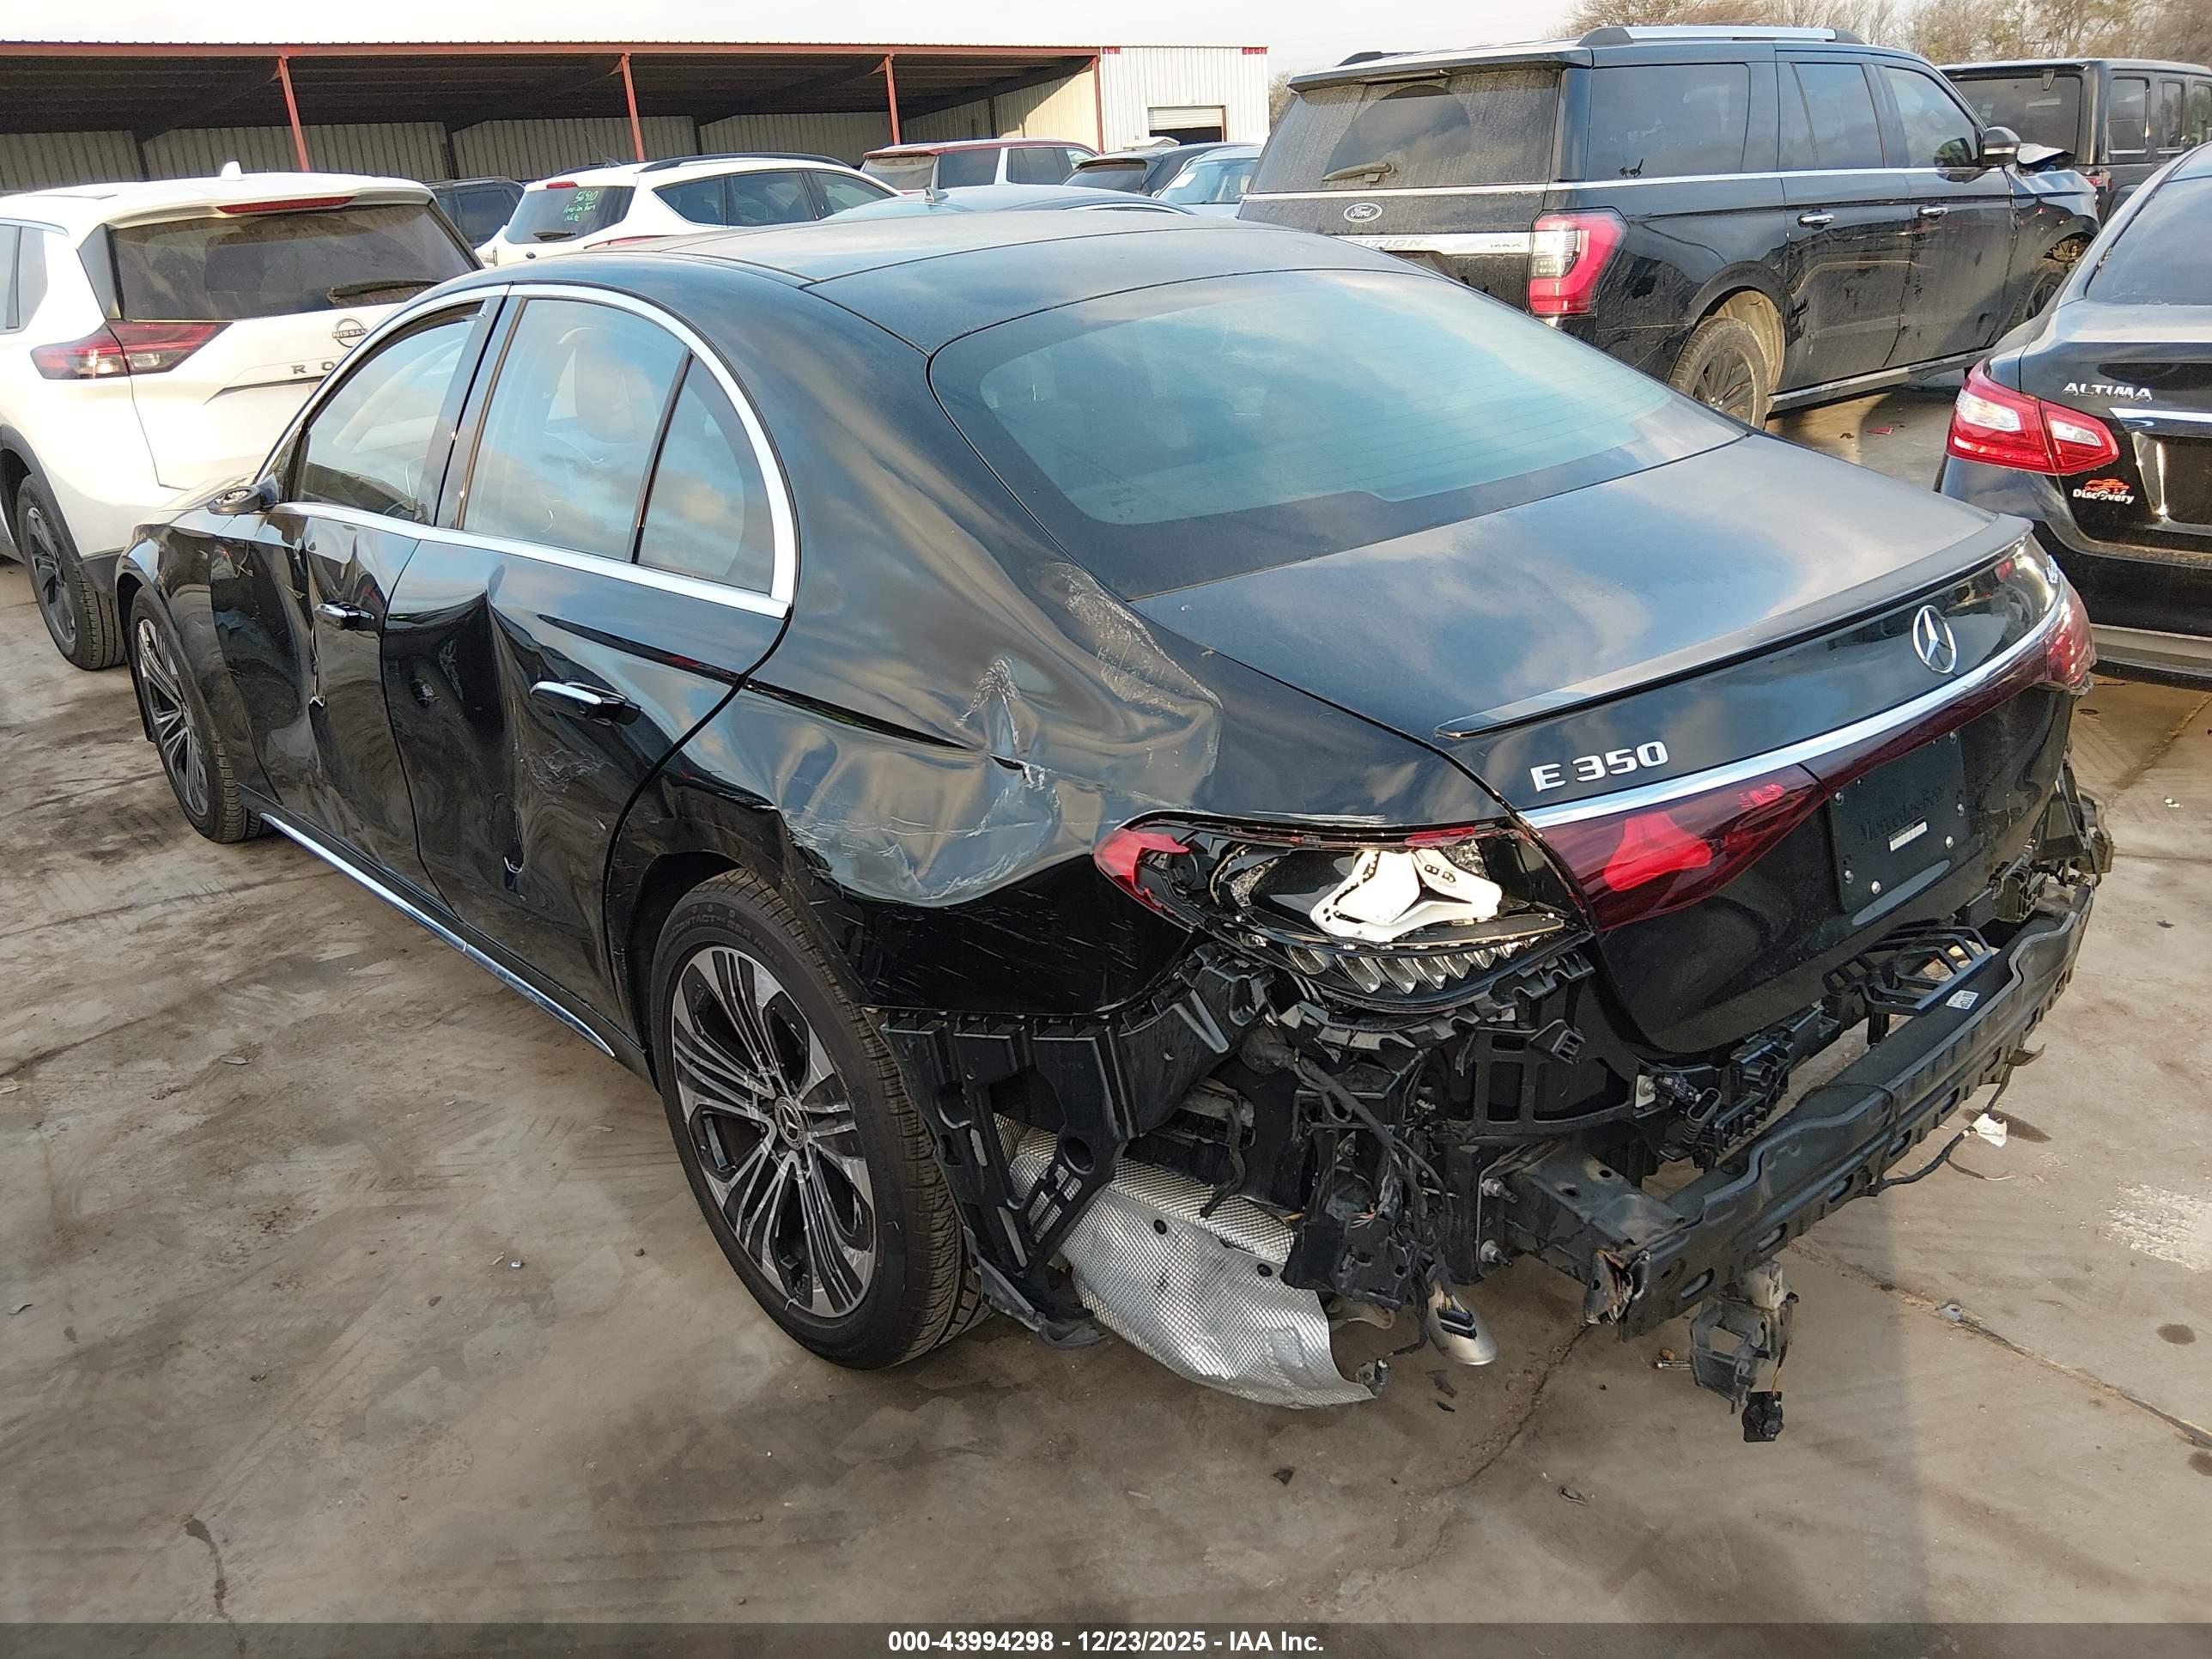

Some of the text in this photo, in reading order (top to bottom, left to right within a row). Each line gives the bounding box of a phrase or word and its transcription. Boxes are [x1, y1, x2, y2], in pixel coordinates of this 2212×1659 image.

[1351, 205, 1373, 217] Ford
[332, 329, 369, 337] NISSAN
[290, 361, 336, 374] RO
[2061, 382, 2153, 402] ALTIMA
[2072, 489, 2136, 505] Discovery
[1529, 740, 1669, 793] E 350
